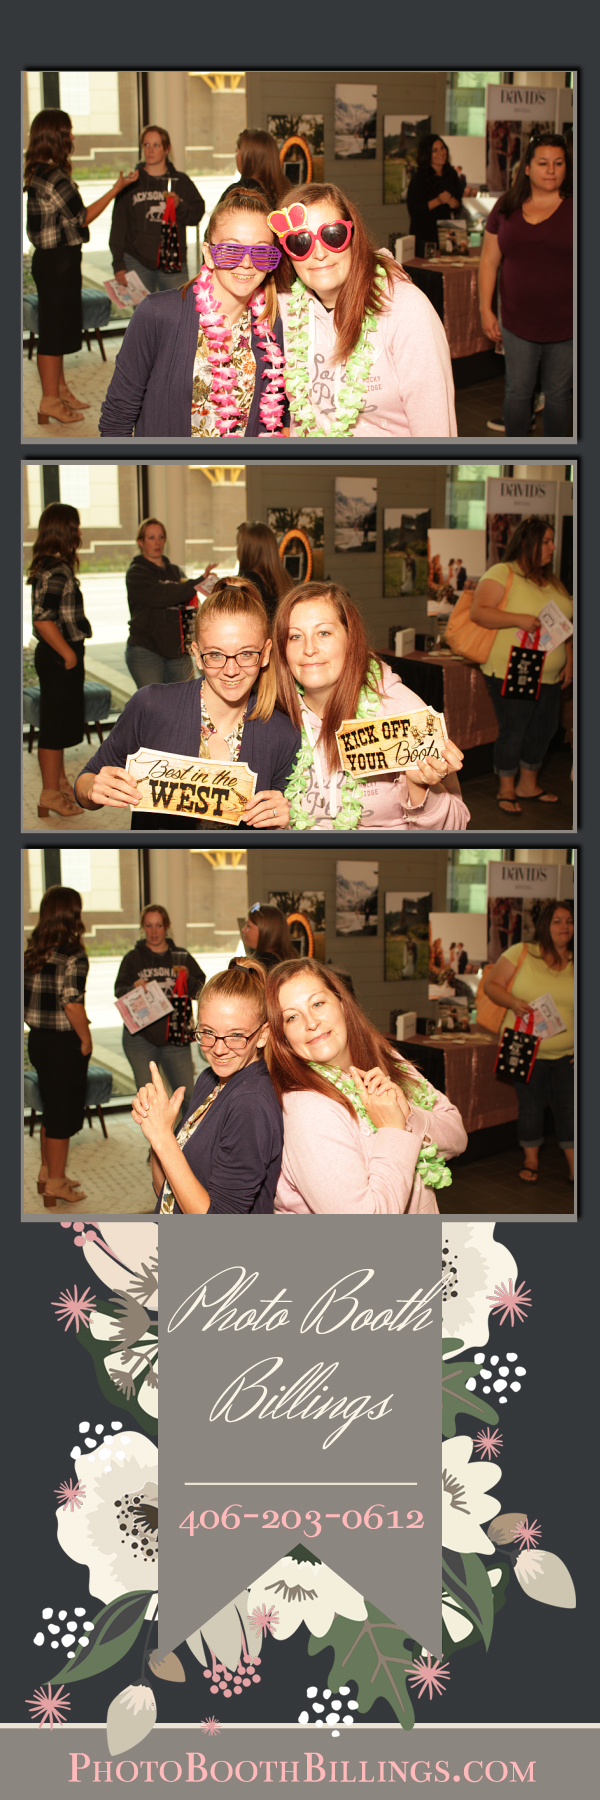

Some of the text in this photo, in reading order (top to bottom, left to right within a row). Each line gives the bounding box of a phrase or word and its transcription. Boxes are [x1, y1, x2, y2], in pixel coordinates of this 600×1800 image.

[132, 190, 165, 206] JACKSON
[340, 719, 411, 752] KICK OFF
[346, 740, 443, 771] YOUR Boots
[134, 759, 238, 788] Best in the
[149, 779, 230, 816] WEST
